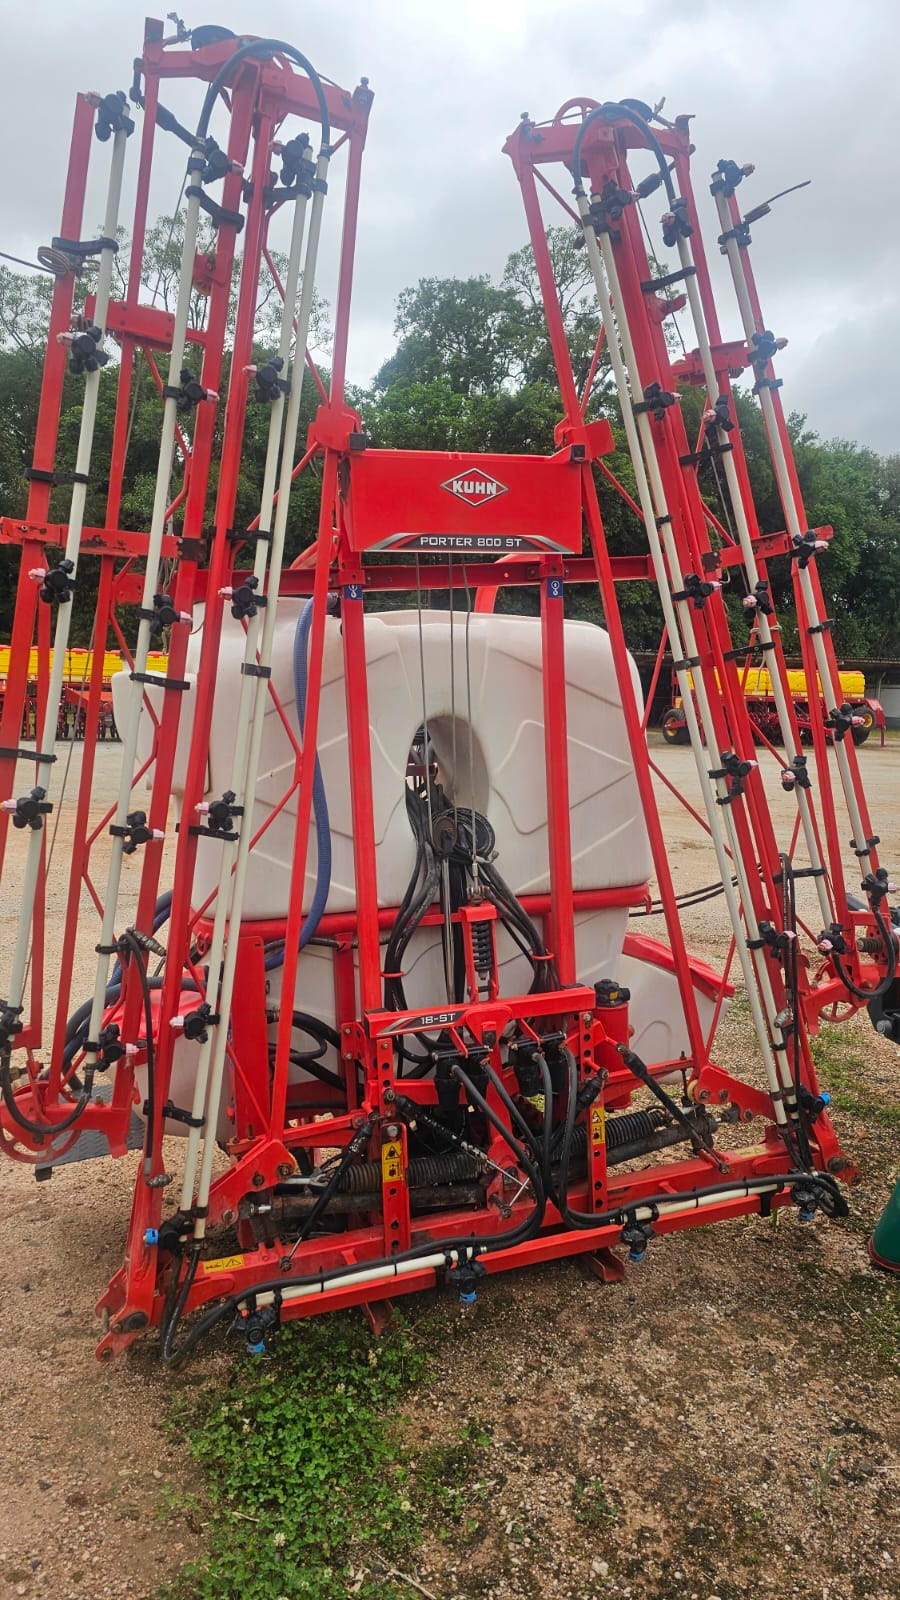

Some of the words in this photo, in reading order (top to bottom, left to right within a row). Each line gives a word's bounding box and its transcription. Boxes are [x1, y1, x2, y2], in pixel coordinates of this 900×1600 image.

[452, 480, 497, 495] KUHN
[420, 536, 472, 546] PORTER
[477, 538, 501, 547] 800
[505, 538, 522, 547] ST
[421, 1012, 456, 1025] 18-ST
